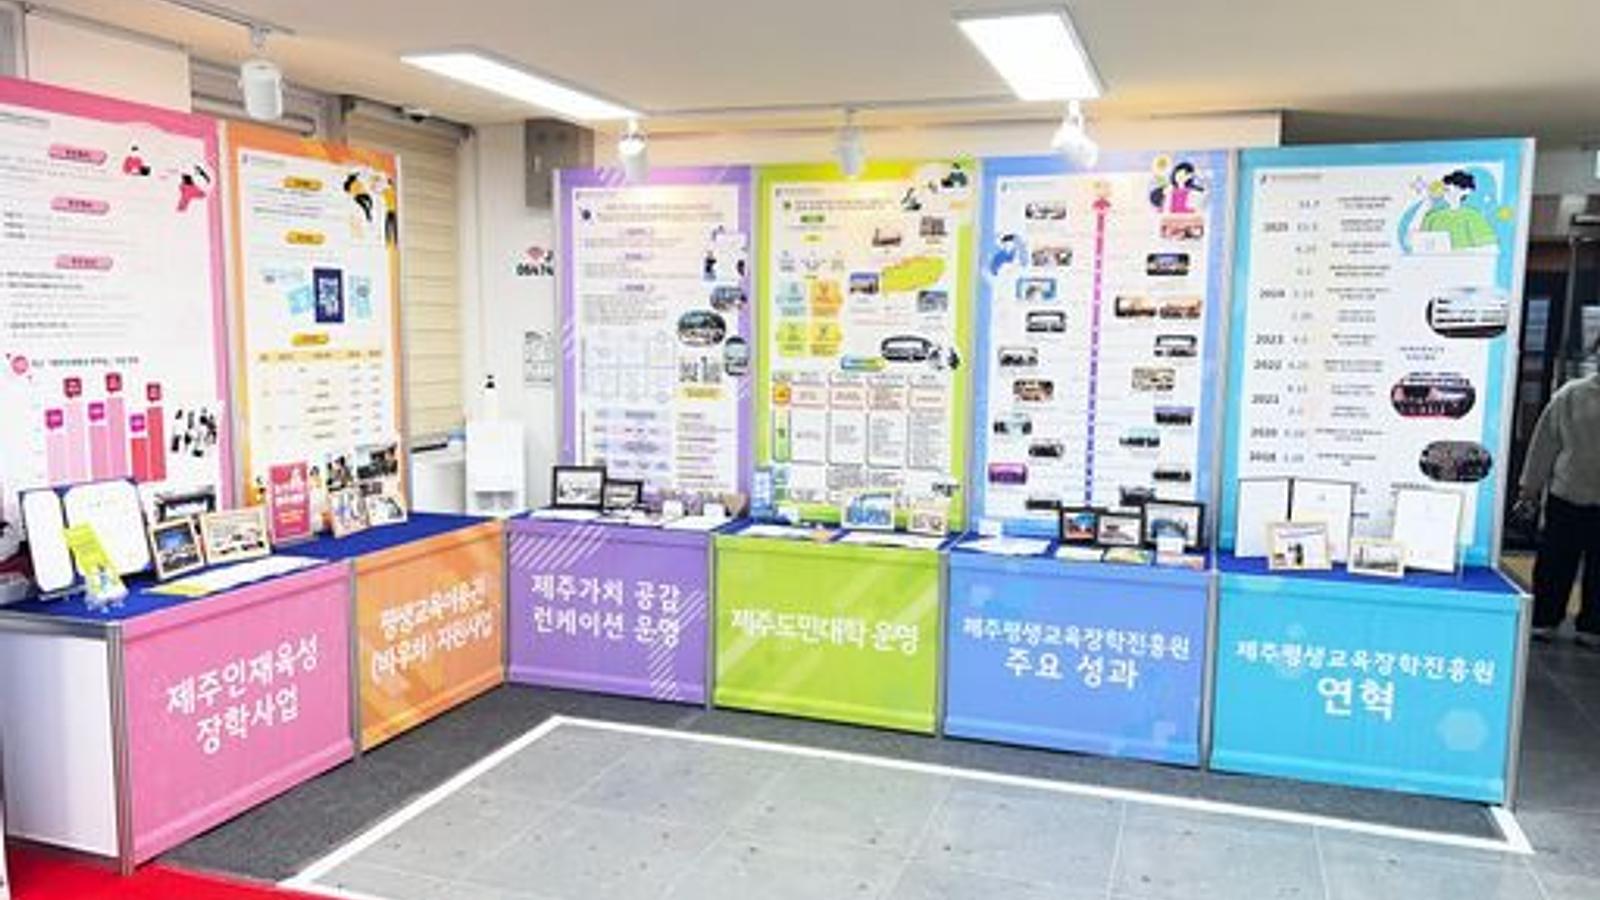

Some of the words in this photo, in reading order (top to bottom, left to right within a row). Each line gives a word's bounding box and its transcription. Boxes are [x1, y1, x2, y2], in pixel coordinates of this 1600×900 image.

[531, 574, 624, 606] 제주가치
[634, 581, 681, 615] 공감
[533, 605, 625, 640] 런케이션
[633, 614, 681, 648] 운영
[730, 608, 868, 650] 제주도민대학
[871, 620, 919, 656] 운영
[962, 616, 1191, 661] 제주평생교육장학진흥원
[165, 632, 320, 715] 제주인재육성
[1004, 647, 1064, 680] 주요
[1076, 654, 1140, 690] 성과
[1236, 639, 1497, 686] 제주평생교육장학진흥원
[196, 683, 300, 755] 장학사업
[1316, 676, 1396, 722] 연혁
